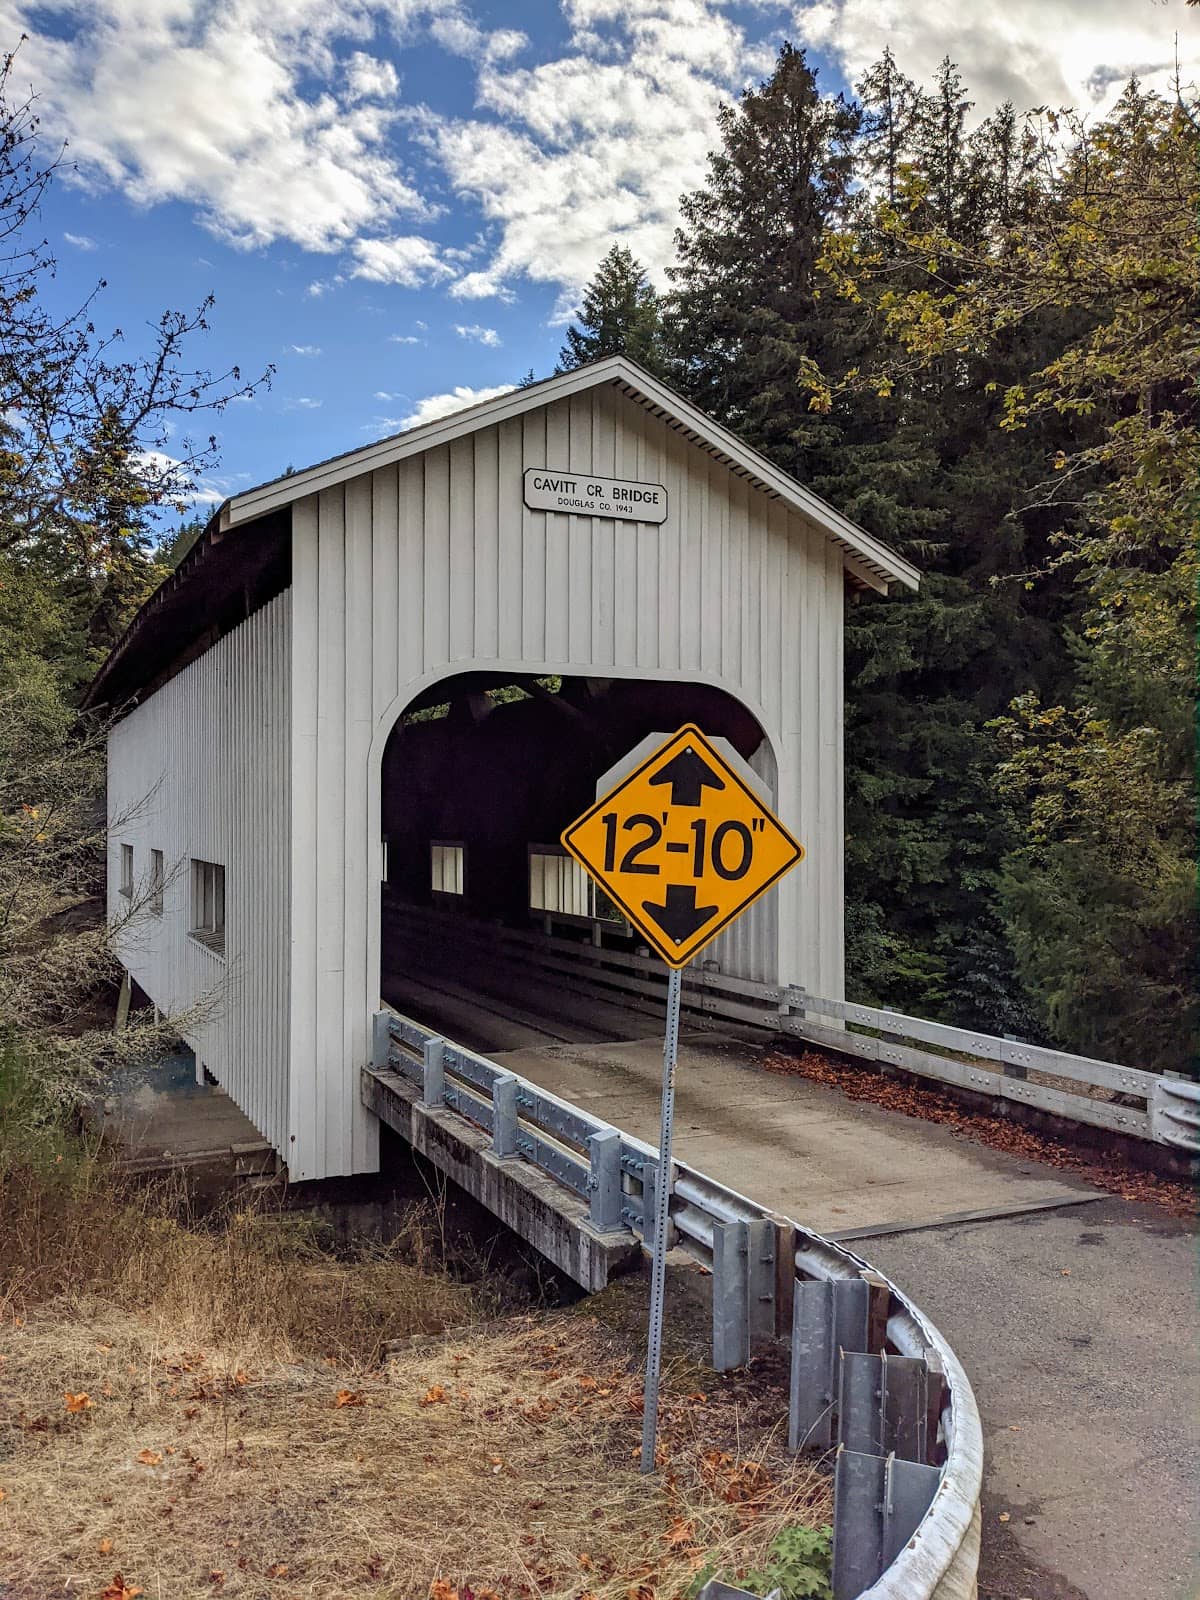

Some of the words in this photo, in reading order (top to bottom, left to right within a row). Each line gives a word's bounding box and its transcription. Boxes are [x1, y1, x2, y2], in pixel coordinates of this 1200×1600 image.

[533, 477, 577, 494] CAVITT
[586, 484, 604, 498] CR.
[612, 487, 659, 505] BRIDGE
[557, 497, 595, 509] DOUGLAS
[599, 502, 612, 511] CO.
[615, 504, 633, 513] 1943
